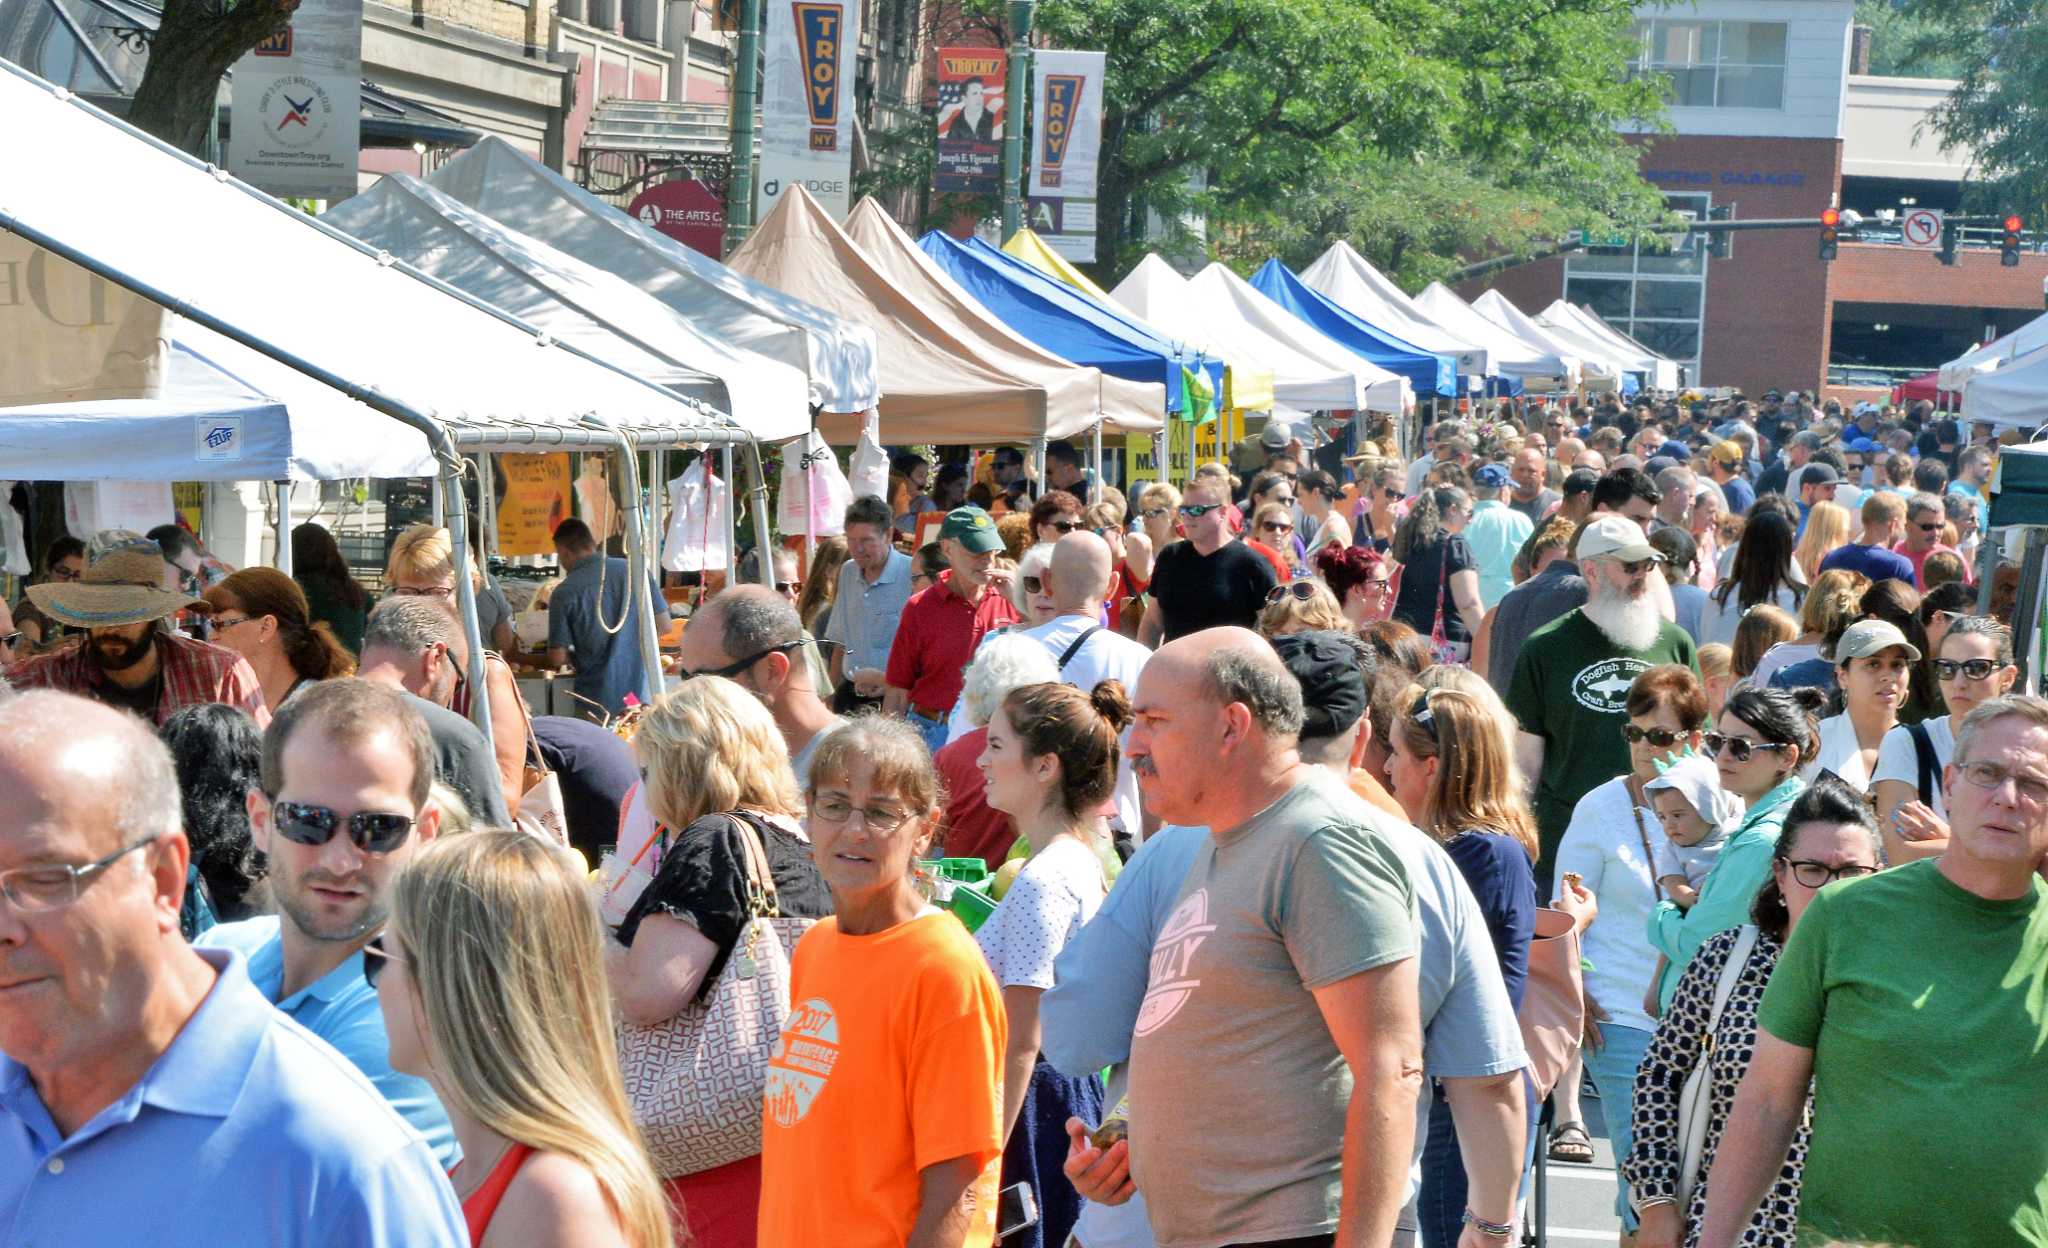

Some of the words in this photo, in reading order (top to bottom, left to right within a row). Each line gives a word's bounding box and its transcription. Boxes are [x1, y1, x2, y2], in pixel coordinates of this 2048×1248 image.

[814, 15, 836, 106] TROY
[1047, 84, 1066, 154] TROY
[814, 133, 833, 146] NY
[664, 209, 686, 220] THE
[687, 211, 710, 221] ARTS
[1580, 662, 1620, 685] Dogfish
[1581, 691, 1604, 707] Craft
[791, 1003, 833, 1034] 2017
